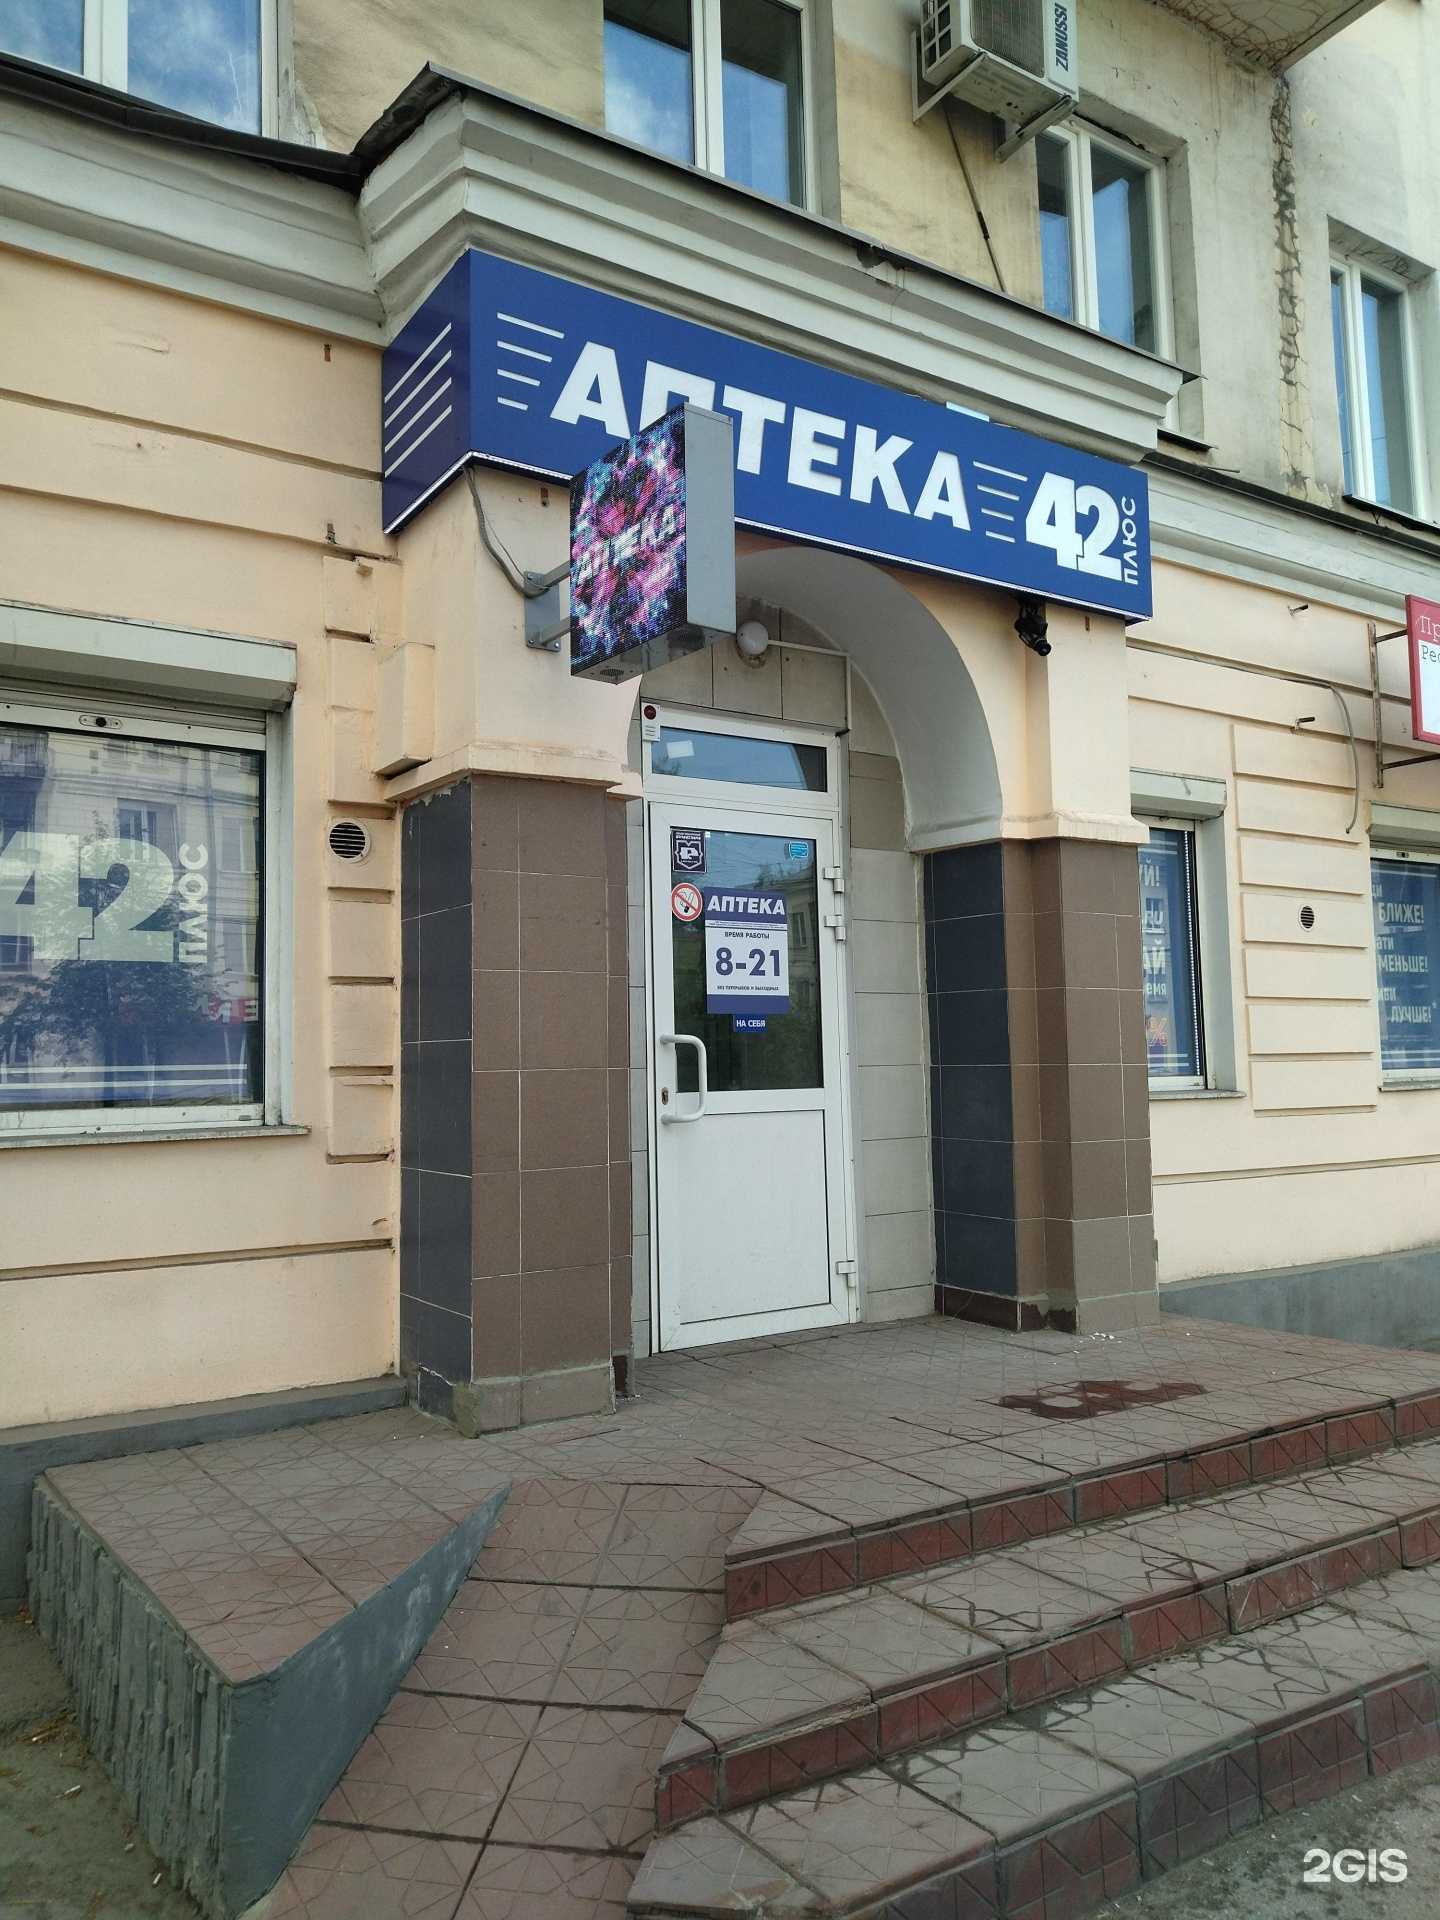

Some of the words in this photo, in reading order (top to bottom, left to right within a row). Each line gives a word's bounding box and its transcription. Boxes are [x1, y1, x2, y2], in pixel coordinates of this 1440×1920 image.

[1055, 3, 1068, 72] ZANUSSI
[550, 341, 971, 532] АПТЕКА
[1025, 471, 1122, 581] 42
[1121, 496, 1138, 585] ПЛЮС
[0, 831, 174, 962] 42
[178, 843, 208, 963] ПЛЮС
[707, 895, 785, 915] АПТЕКА
[1378, 902, 1425, 924] БЛИЖЕ!
[724, 931, 744, 939] ВРЕМЯ
[745, 932, 770, 941] РАБОТЫ
[716, 947, 780, 977] 8-21
[1379, 954, 1428, 973] МЕНЬШЕ!
[736, 1019, 746, 1028] НА
[747, 1019, 766, 1028] СЕБЯ
